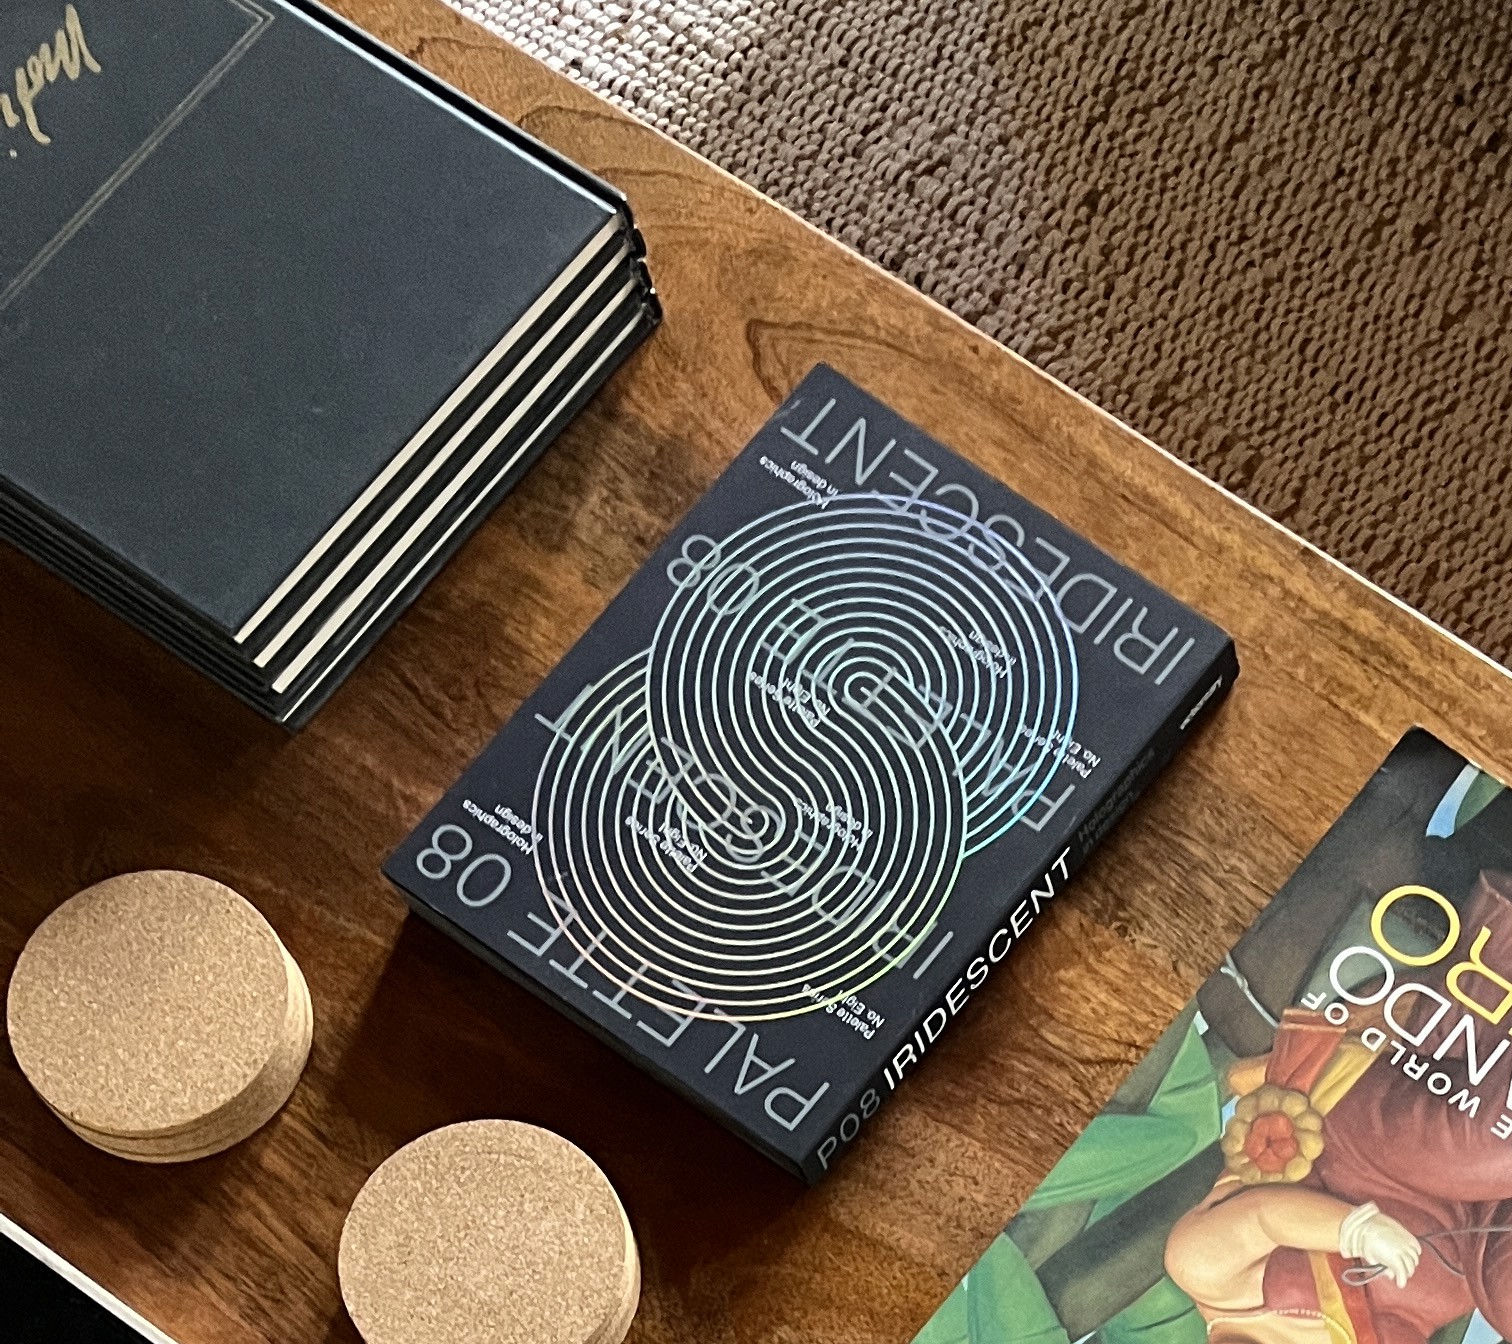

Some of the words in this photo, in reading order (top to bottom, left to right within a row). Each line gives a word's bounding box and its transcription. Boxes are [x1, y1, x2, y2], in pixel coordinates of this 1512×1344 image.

[667, 533, 758, 617] 08
[779, 397, 1196, 686] IRIDESCENT
[760, 596, 1075, 832] PALETTE
[417, 823, 508, 904] 08
[458, 795, 536, 855] Holographics
[533, 682, 954, 979] IRIDESCENT
[505, 888, 830, 1131] PALETTE
[815, 1088, 881, 1170] P08
[884, 846, 1072, 1091] IRIDESCENT
[833, 1005, 876, 1040] Palette
[1299, 990, 1347, 1023] OF
[1360, 1026, 1480, 1118] WORLD
